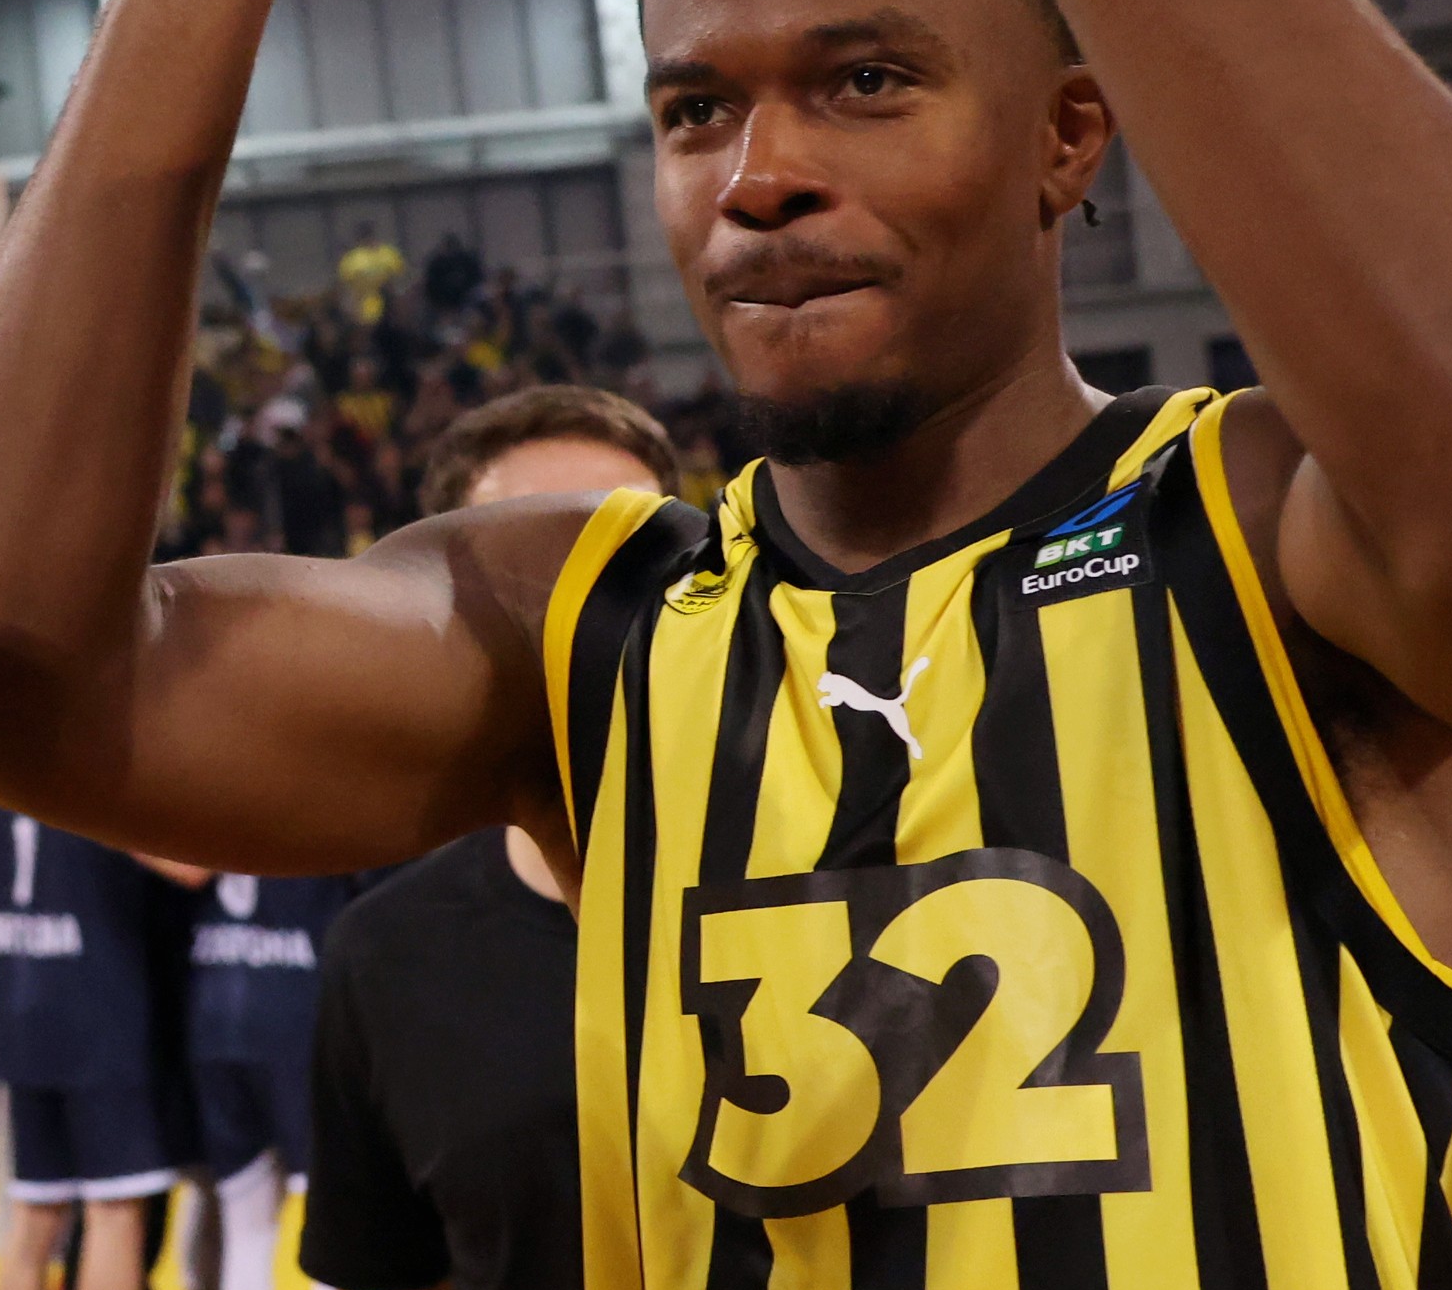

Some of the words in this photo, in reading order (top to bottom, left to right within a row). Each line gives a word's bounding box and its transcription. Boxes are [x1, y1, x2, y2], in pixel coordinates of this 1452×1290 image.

[1036, 525, 1123, 566] BKT
[1021, 553, 1140, 595] EuroCup
[699, 876, 1118, 1188] 32
